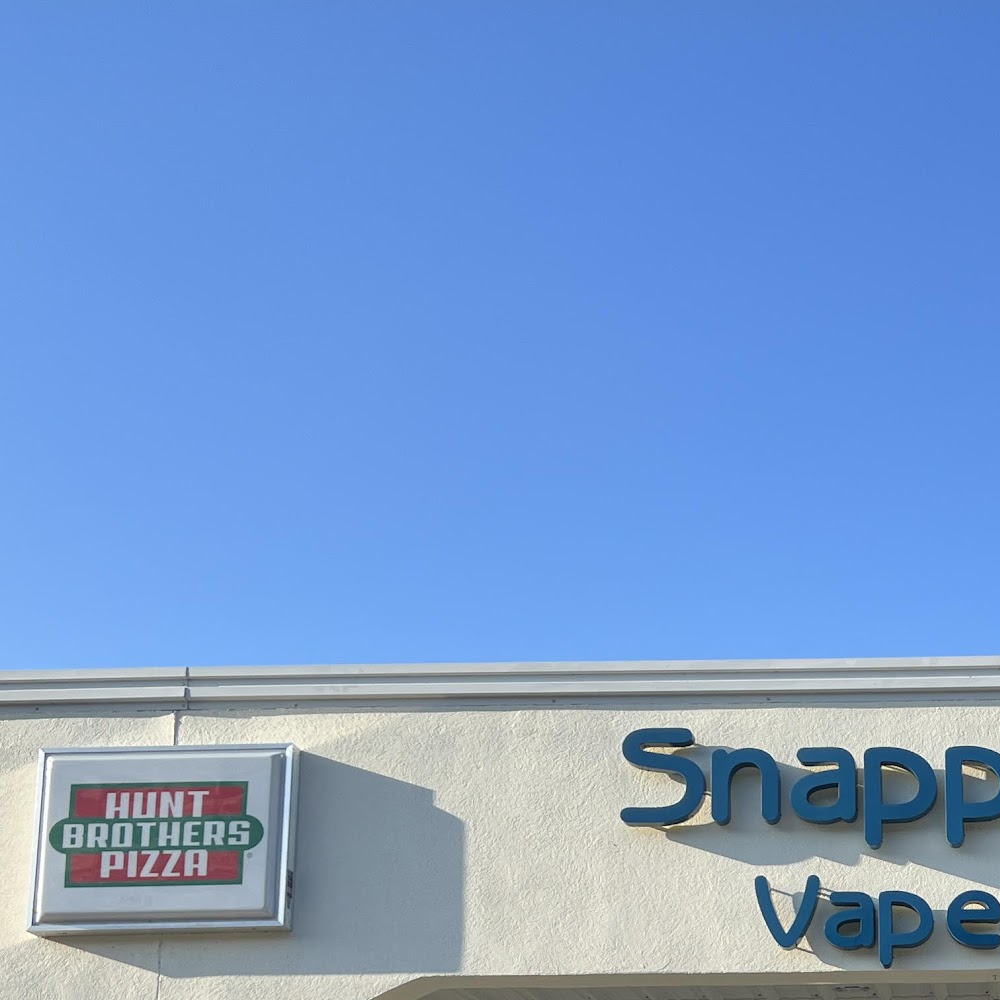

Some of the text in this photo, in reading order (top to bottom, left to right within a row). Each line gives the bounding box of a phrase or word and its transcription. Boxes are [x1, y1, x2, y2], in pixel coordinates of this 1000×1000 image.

[105, 791, 210, 819] HUNT
[62, 821, 251, 849] BROTHERS
[100, 849, 208, 878] PIZZA
